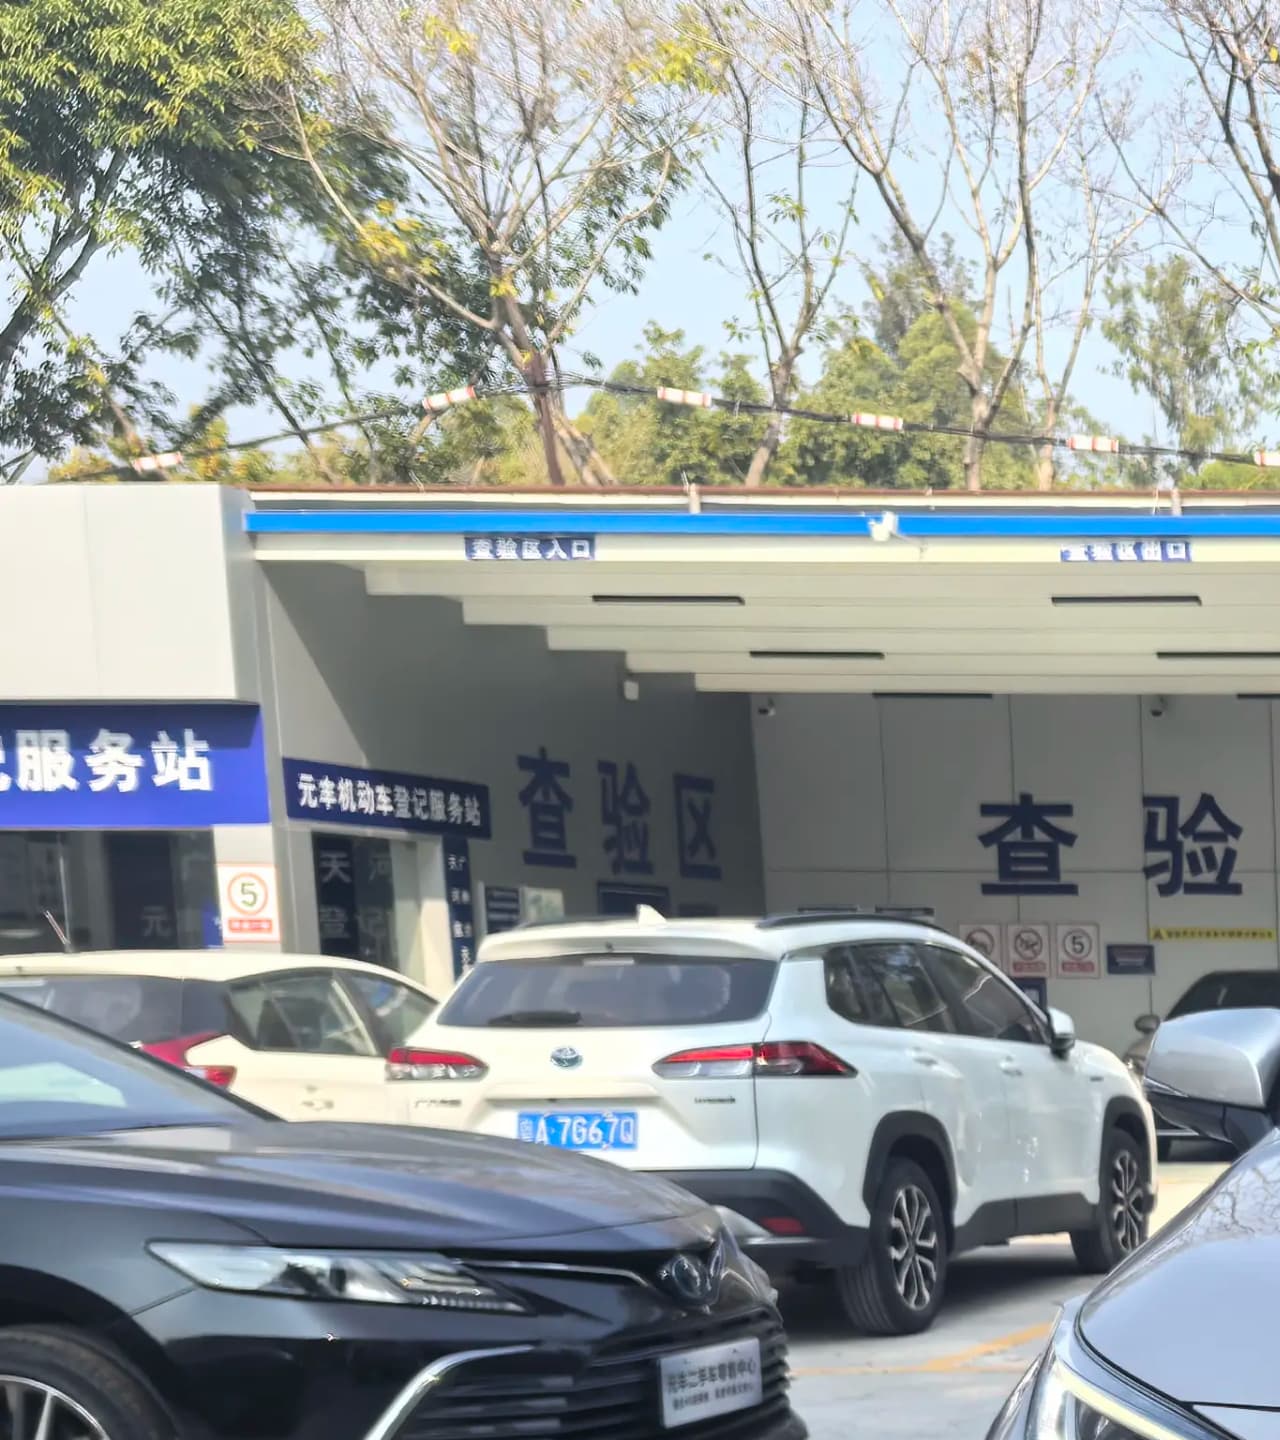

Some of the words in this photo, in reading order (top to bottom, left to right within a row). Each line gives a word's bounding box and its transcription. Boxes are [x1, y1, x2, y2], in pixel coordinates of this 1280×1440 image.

[472, 537, 590, 560] 查验区入口
[516, 746, 722, 880] 查验区
[240, 882, 258, 907] 5
[1071, 936, 1084, 951] 5
